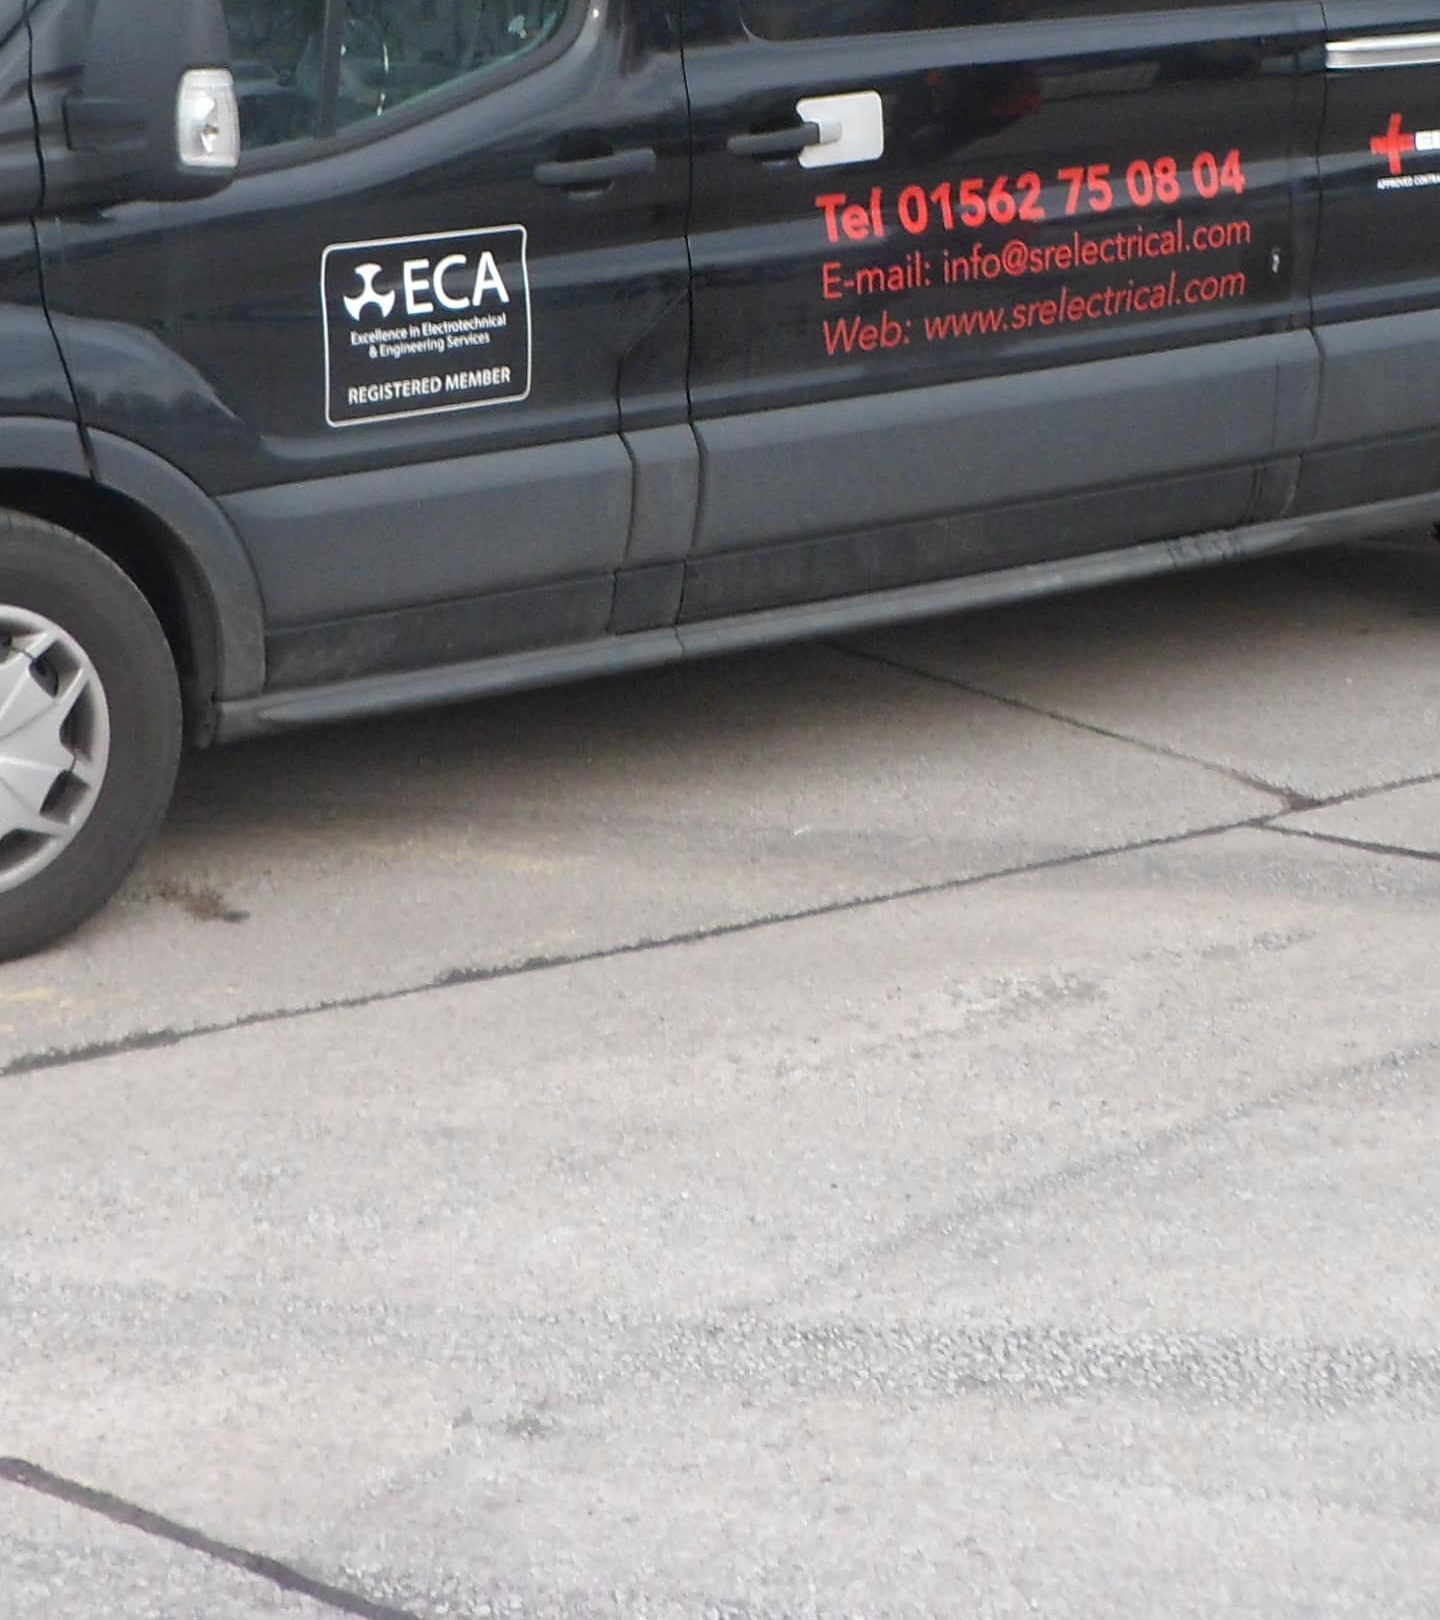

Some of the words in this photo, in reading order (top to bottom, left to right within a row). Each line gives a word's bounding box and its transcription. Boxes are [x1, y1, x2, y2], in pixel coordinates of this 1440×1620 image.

[815, 185, 885, 244] Tel
[898, 171, 1046, 235] 01562
[1058, 163, 1113, 216] 75
[1126, 156, 1182, 207] 08
[1192, 148, 1246, 199] 04
[402, 250, 510, 315] ECA
[822, 250, 932, 300] E-mail:
[943, 217, 1251, 285] info@srelectrical.com
[350, 327, 408, 346] Excellence
[409, 324, 421, 338] in
[421, 312, 507, 337] Electrotechnical
[368, 344, 378, 358] &
[379, 337, 445, 359] Engineering
[446, 331, 491, 350] Services
[823, 310, 912, 356] Web:
[924, 270, 1246, 342] www.srelectrical.com
[348, 376, 443, 405] REGISTERED
[444, 366, 512, 393] MEMBER
